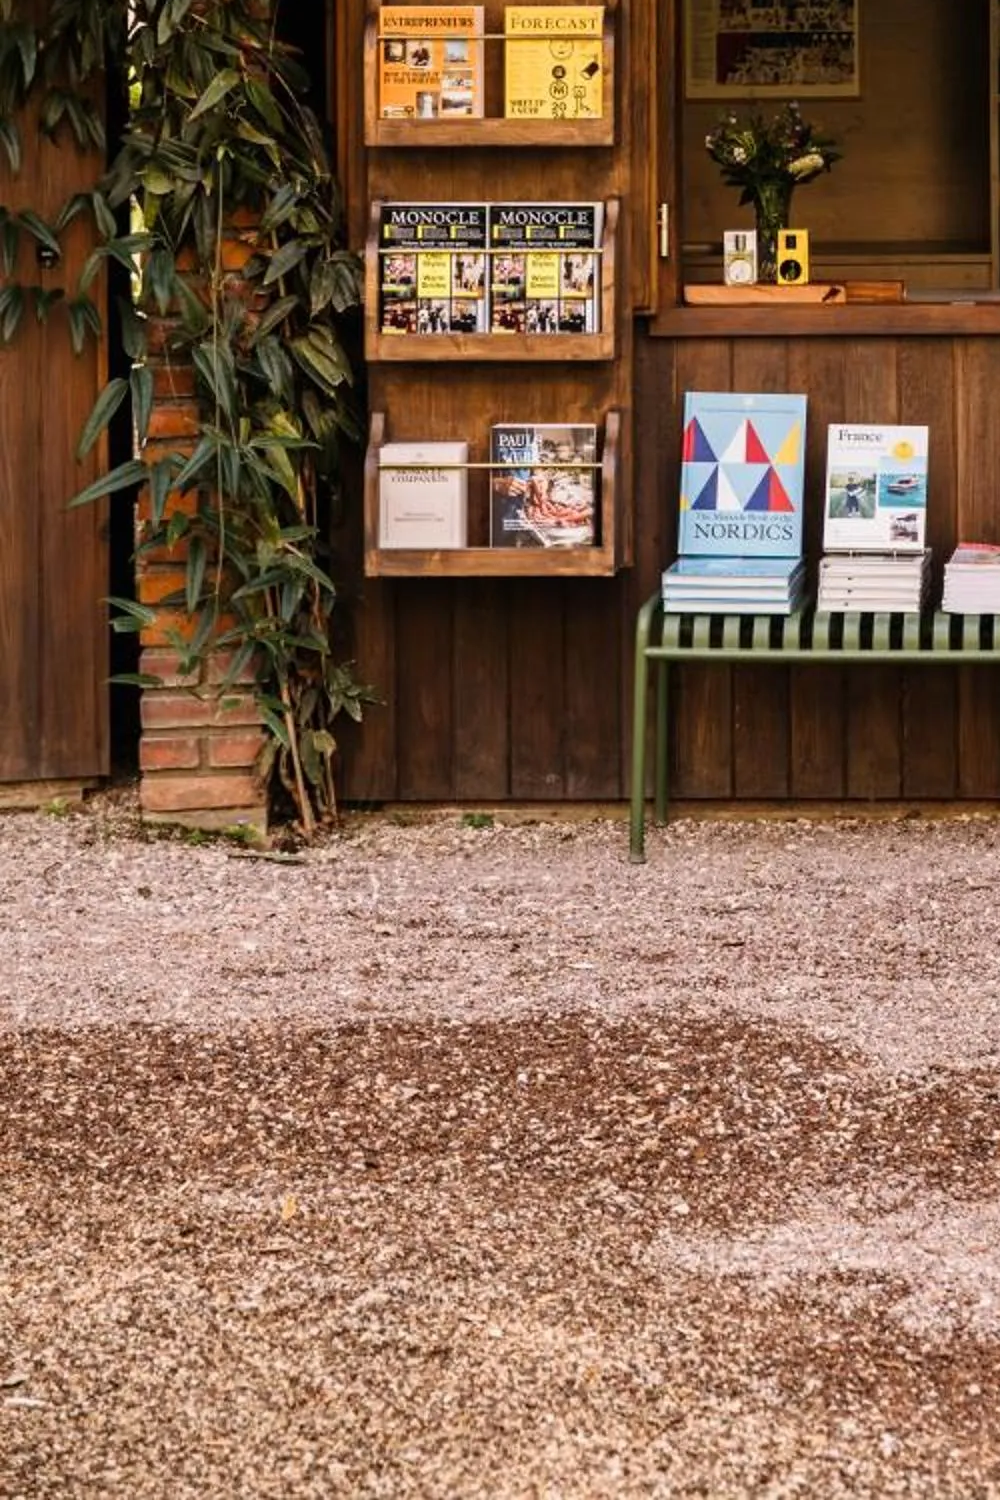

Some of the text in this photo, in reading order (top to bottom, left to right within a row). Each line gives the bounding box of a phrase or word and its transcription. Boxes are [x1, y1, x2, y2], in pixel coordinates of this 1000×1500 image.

[511, 17, 597, 30] FORECAST
[391, 211, 479, 224] MONOCLE
[499, 211, 588, 224] MONOCLE
[838, 429, 883, 443] France
[694, 522, 793, 540] NORDICS
